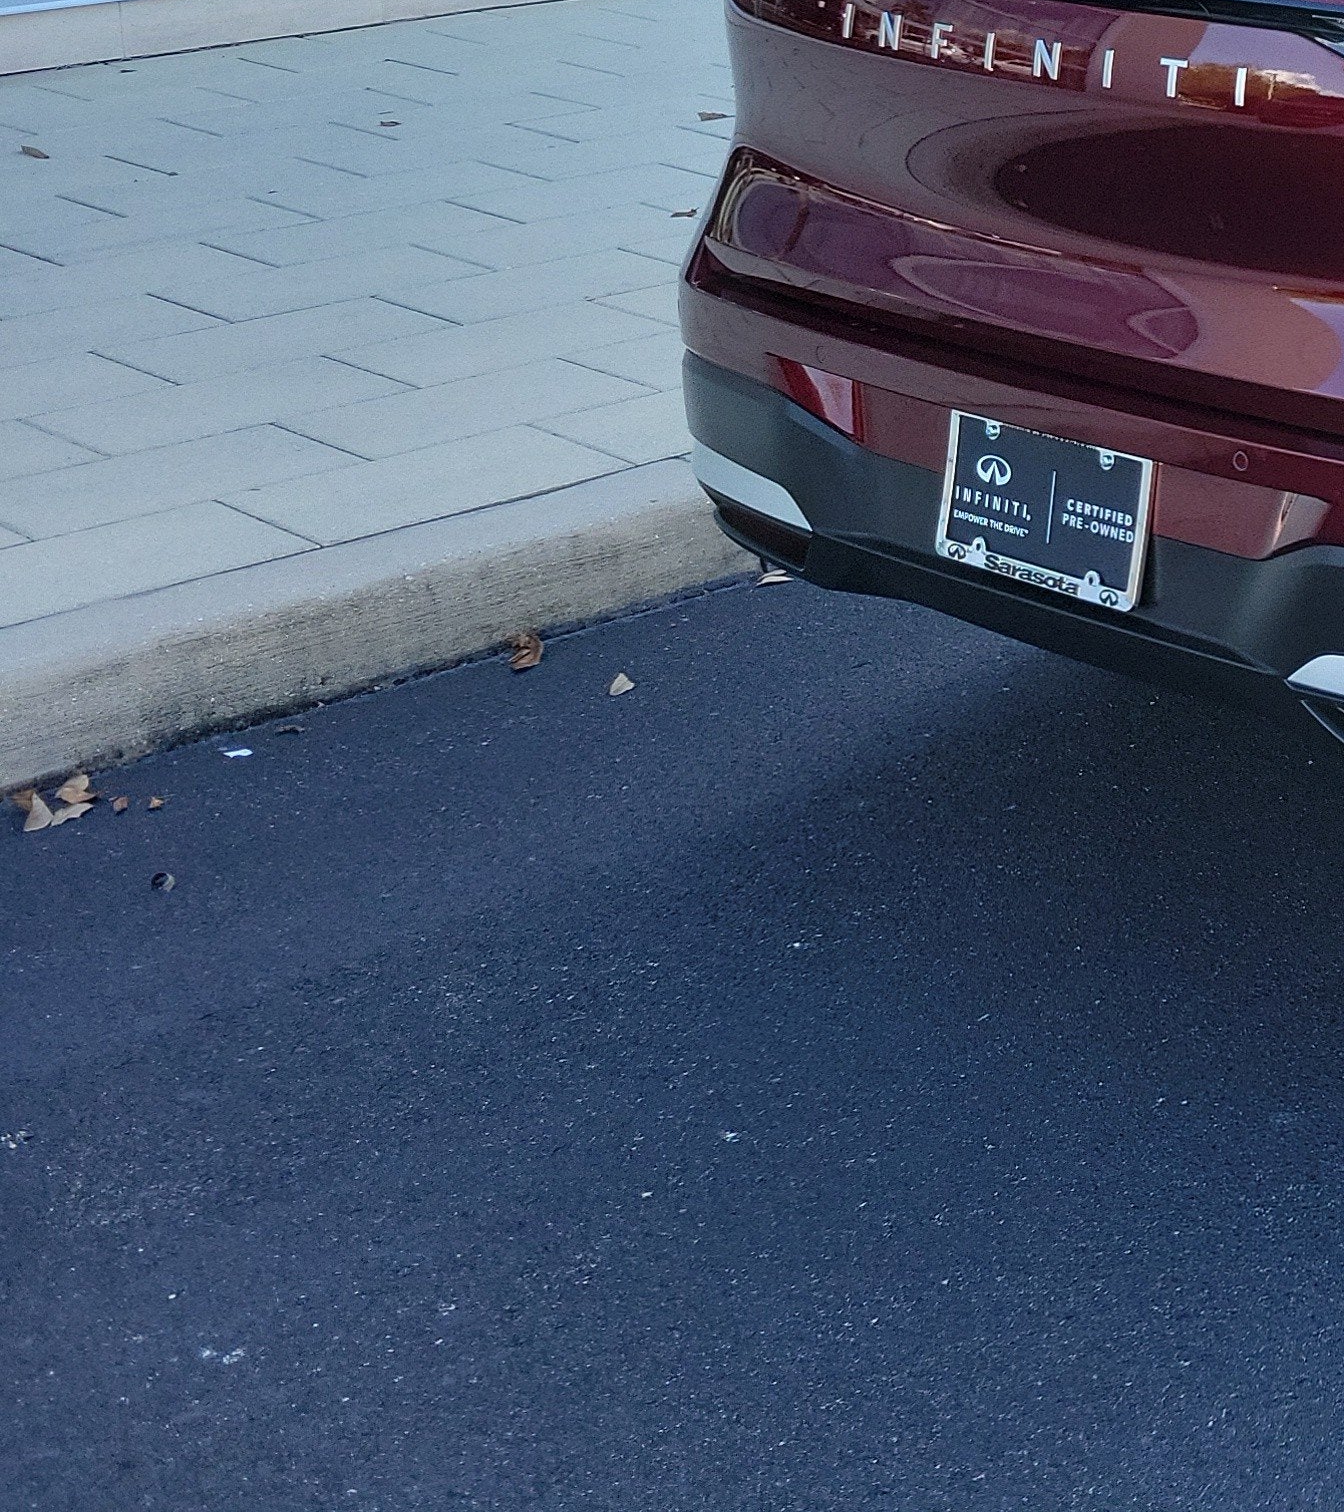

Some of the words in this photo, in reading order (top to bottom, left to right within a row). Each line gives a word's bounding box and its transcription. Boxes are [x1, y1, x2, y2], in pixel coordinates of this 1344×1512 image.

[841, 1, 1248, 107] INFINITI
[955, 485, 1029, 520] INFINITI
[1066, 498, 1133, 526] CERTIFIED
[953, 508, 989, 527] EMPOWER
[989, 518, 1004, 532] THE
[1062, 512, 1135, 543] PRE-OWNED
[983, 553, 1079, 596] Sarasota
